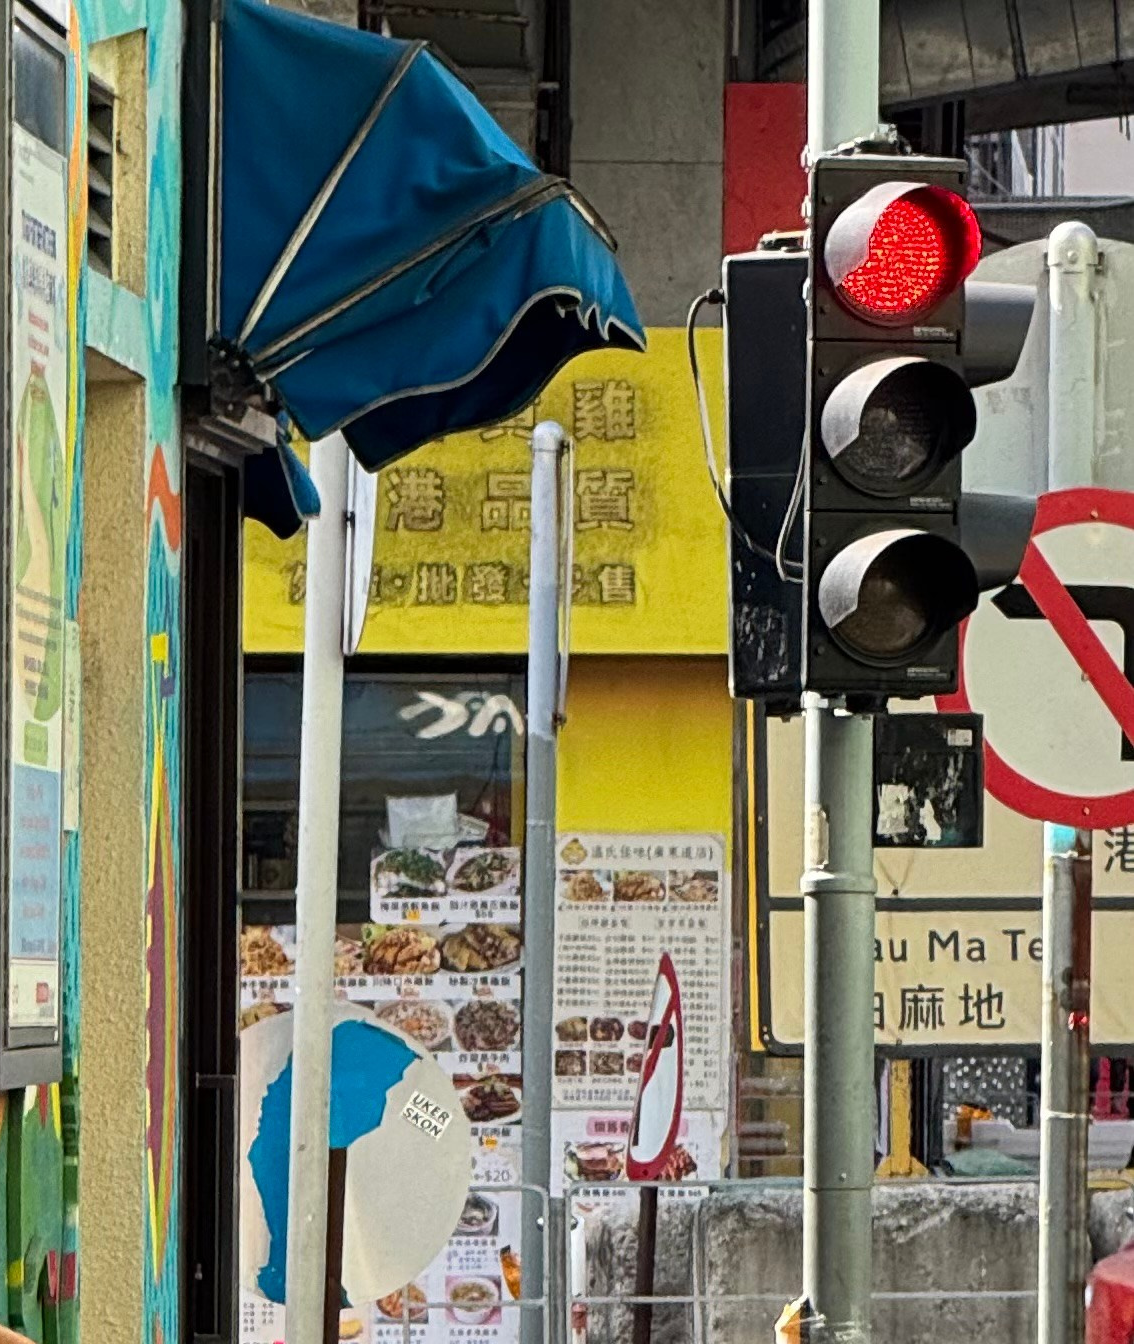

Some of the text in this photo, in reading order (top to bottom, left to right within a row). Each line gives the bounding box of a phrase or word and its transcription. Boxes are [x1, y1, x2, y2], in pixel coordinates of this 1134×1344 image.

[874, 929, 1043, 962] au Ma Te
[402, 1107, 443, 1137] SKON
